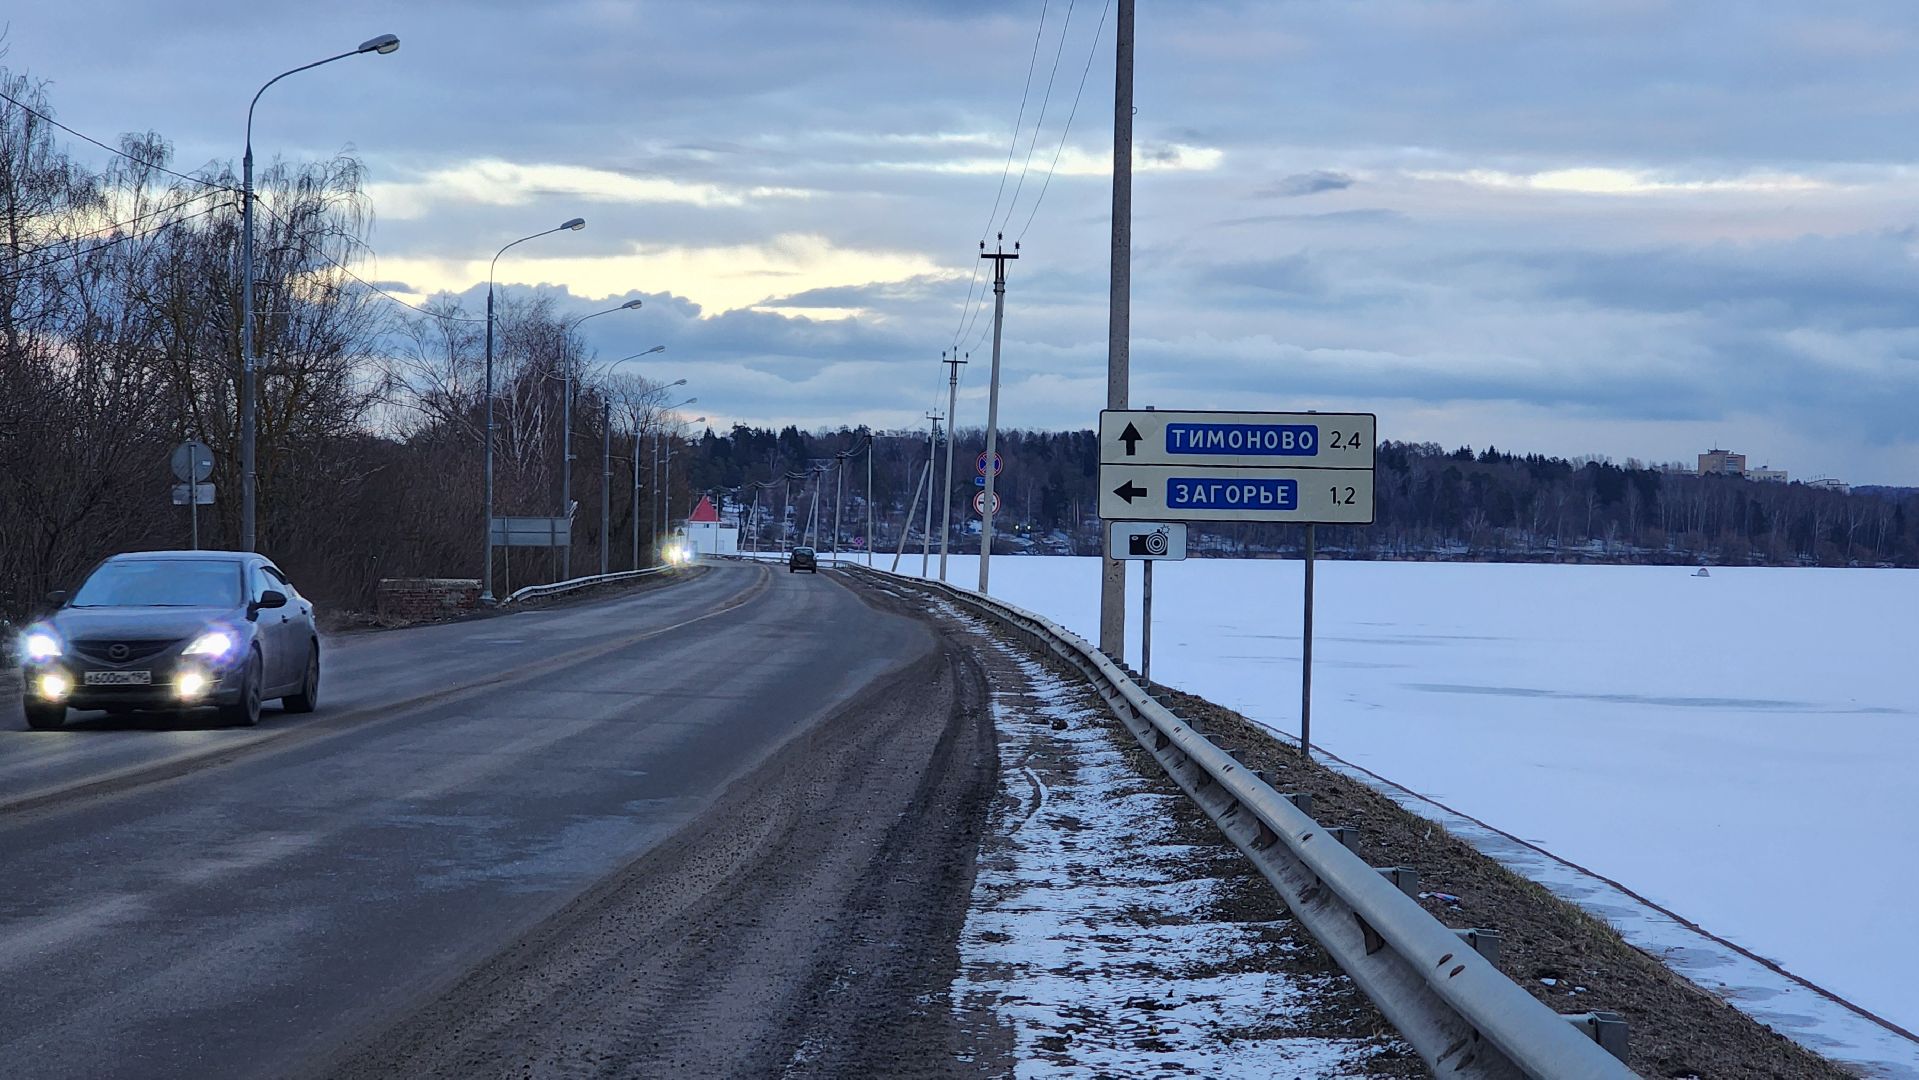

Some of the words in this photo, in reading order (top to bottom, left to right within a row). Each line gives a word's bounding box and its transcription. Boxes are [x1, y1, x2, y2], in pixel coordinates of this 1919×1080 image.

[1171, 429, 1314, 450] ТИМОНОВО
[1330, 430, 1362, 450] 2,4
[1175, 484, 1290, 505] ЗАГОРЬЕ
[1329, 486, 1357, 506] 1,2
